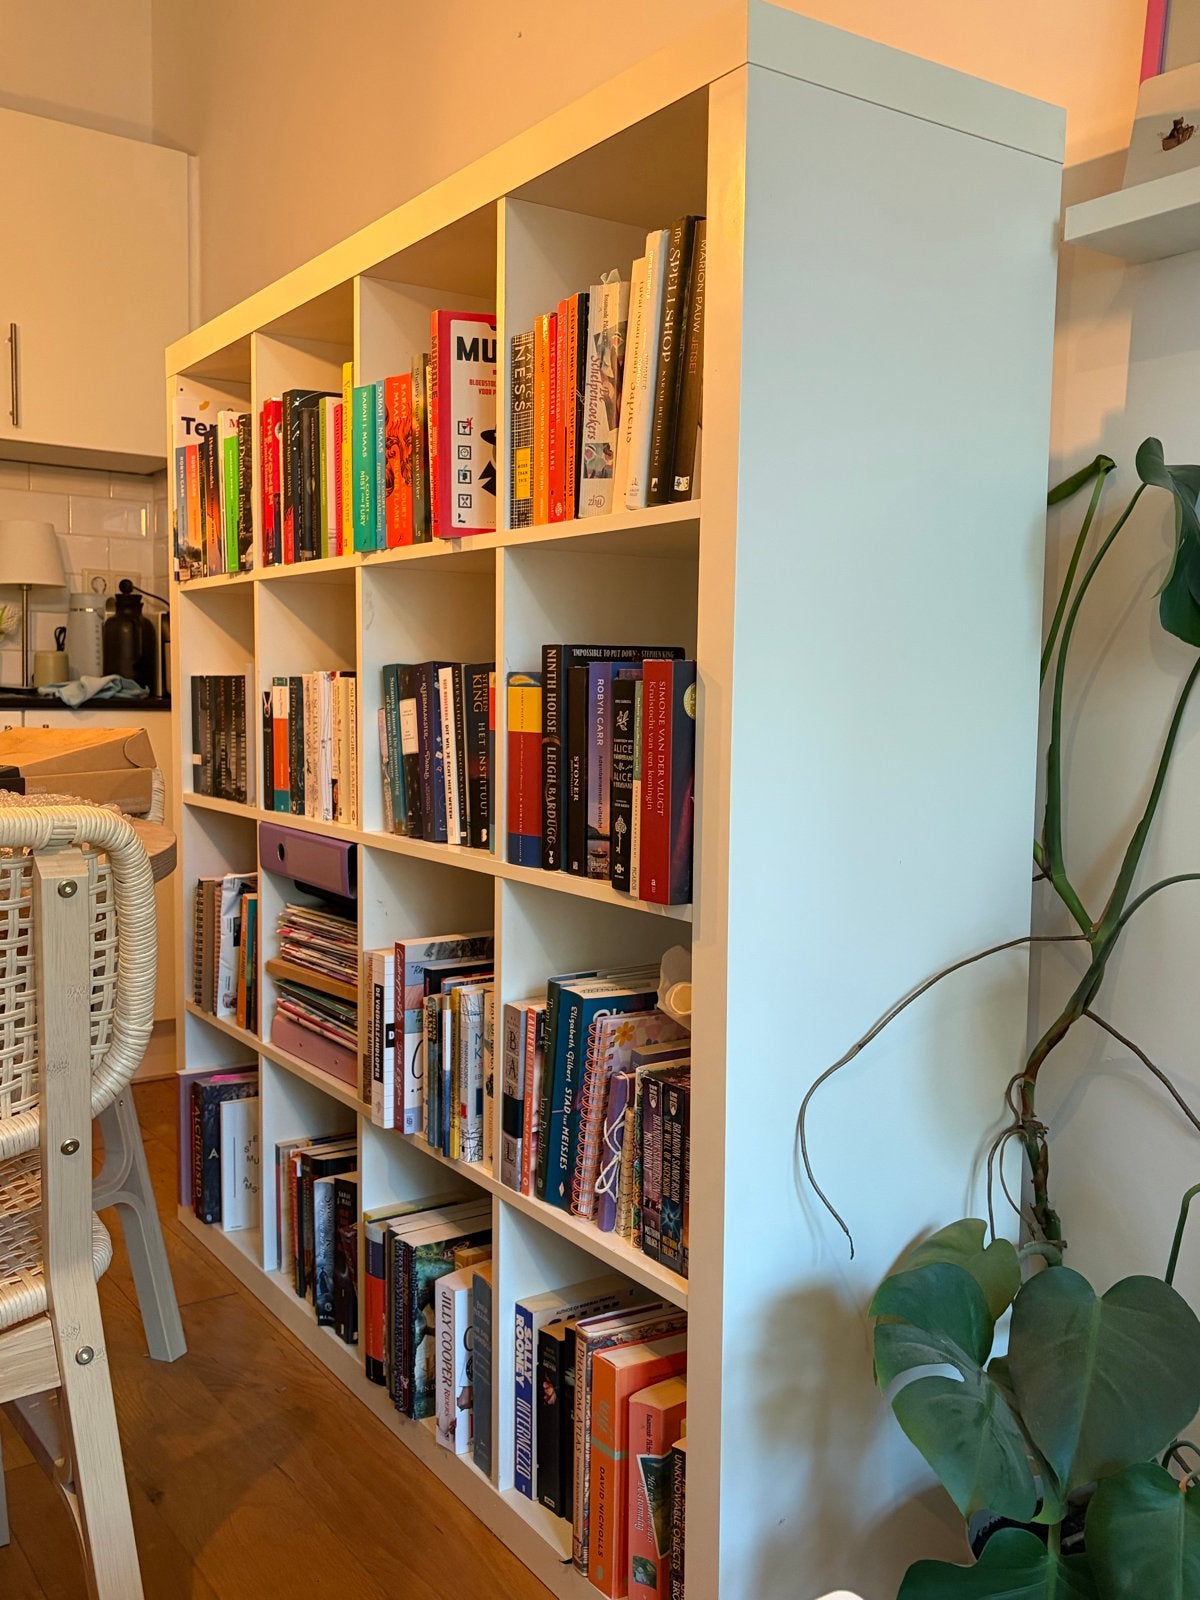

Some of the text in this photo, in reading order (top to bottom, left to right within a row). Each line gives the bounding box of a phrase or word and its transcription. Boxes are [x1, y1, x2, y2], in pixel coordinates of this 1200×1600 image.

[673, 227, 682, 245] THE
[661, 248, 681, 363] SPELLSHOP
[688, 239, 706, 375] MARION PAUW JETSET
[514, 345, 526, 412] NESS
[586, 355, 602, 441] Schelpenzoekers
[600, 387, 609, 403] De
[659, 370, 667, 402] SARAH
[653, 433, 661, 467] DURST
[546, 649, 557, 689] NINTH
[572, 648, 602, 657] 'IMPOSSIBLE
[603, 649, 610, 657] TO
[610, 649, 620, 658] PUT
[641, 650, 662, 658] STEPHEN
[420, 682, 429, 740] KLEERMAAKSTER
[454, 670, 463, 741] GREENLIGHTS
[472, 674, 483, 713] KING
[546, 693, 557, 733] HOUSE
[648, 680, 656, 730] Kruistocht
[597, 717, 605, 746] CARR
[613, 744, 633, 754] ALICE
[657, 680, 666, 817] SIMONE VAN DER VLUGT
[478, 722, 488, 817] HET INSTITUUT
[546, 746, 557, 783] LEIGH
[613, 772, 632, 782] ALICE
[646, 770, 655, 811] koningin
[375, 986, 381, 997] DE
[527, 1012, 535, 1052] LAUREN
[568, 1005, 578, 1049] Elizabeth
[538, 998, 554, 1164] Tom Lake Ann Patchett
[565, 1051, 575, 1082] Gilbert
[563, 1087, 573, 1114] STAD
[194, 1106, 202, 1198] ALCHEMISED
[559, 1127, 570, 1170] MEISJES
[643, 1131, 653, 1168] MISTBORN
[652, 1114, 661, 1195] BRANDON SANDERSON
[663, 1151, 671, 1159] OF
[671, 1122, 681, 1205] BRANDON SANDERSON
[662, 1159, 671, 1198] ASCENSION
[556, 1307, 573, 1315] AUTHOR
[441, 1291, 453, 1417] JILLY COOPER RIDERS
[516, 1314, 525, 1388] ROONEY
[524, 1325, 532, 1384] SALLY
[576, 1347, 586, 1411] PHANTOM
[516, 1397, 531, 1480] INTERMEZZO
[576, 1413, 586, 1454] ATLAS
[647, 1473, 657, 1489] Het
[635, 1481, 646, 1531] De stormdag
[673, 1454, 682, 1570] UNKNOWABLE OBJECTS
[597, 1502, 605, 1558] NICHOLLS
